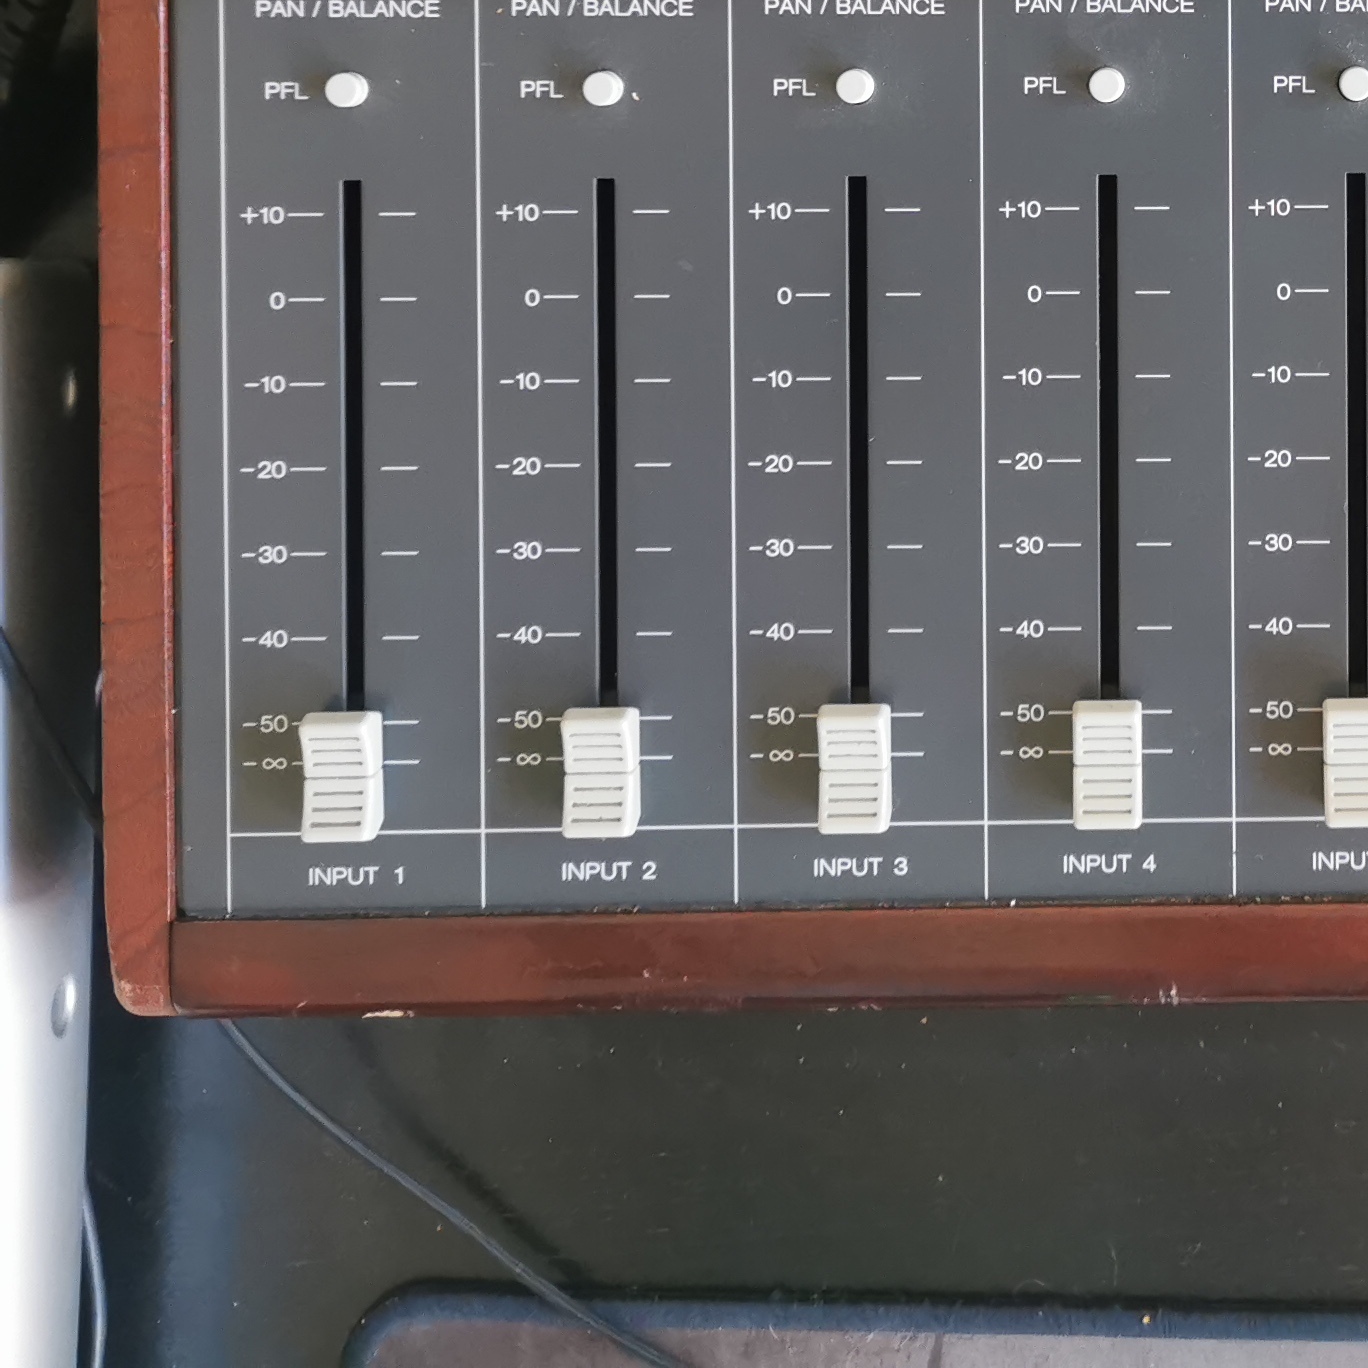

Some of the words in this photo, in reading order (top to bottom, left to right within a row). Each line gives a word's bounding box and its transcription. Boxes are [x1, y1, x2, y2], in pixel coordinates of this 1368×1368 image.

[255, 0, 305, 17] PAN
[312, 1, 321, 17] /
[328, 0, 440, 18] BALANCE
[511, 0, 560, 16] PAN
[567, 0, 576, 16] /
[583, 0, 694, 16] BALANCE
[264, 82, 309, 99] PFL
[520, 80, 564, 98] PFL
[774, 79, 816, 96] PFL
[1024, 77, 1066, 94] PFL
[1274, 76, 1315, 93] PFL
[496, 204, 539, 221] +10
[500, 372, 540, 390] -10
[495, 457, 541, 475] -20
[496, 542, 542, 560] -30
[496, 626, 542, 644] -40
[497, 711, 542, 728] -50
[562, 862, 632, 881] INPUT
[643, 862, 656, 880] 2
[814, 857, 883, 877] INPUT
[893, 857, 908, 875] 3
[1063, 854, 1132, 873] INPUT
[1143, 855, 1156, 872] 4
[309, 866, 379, 885] INPUT
[395, 867, 403, 884] 1
